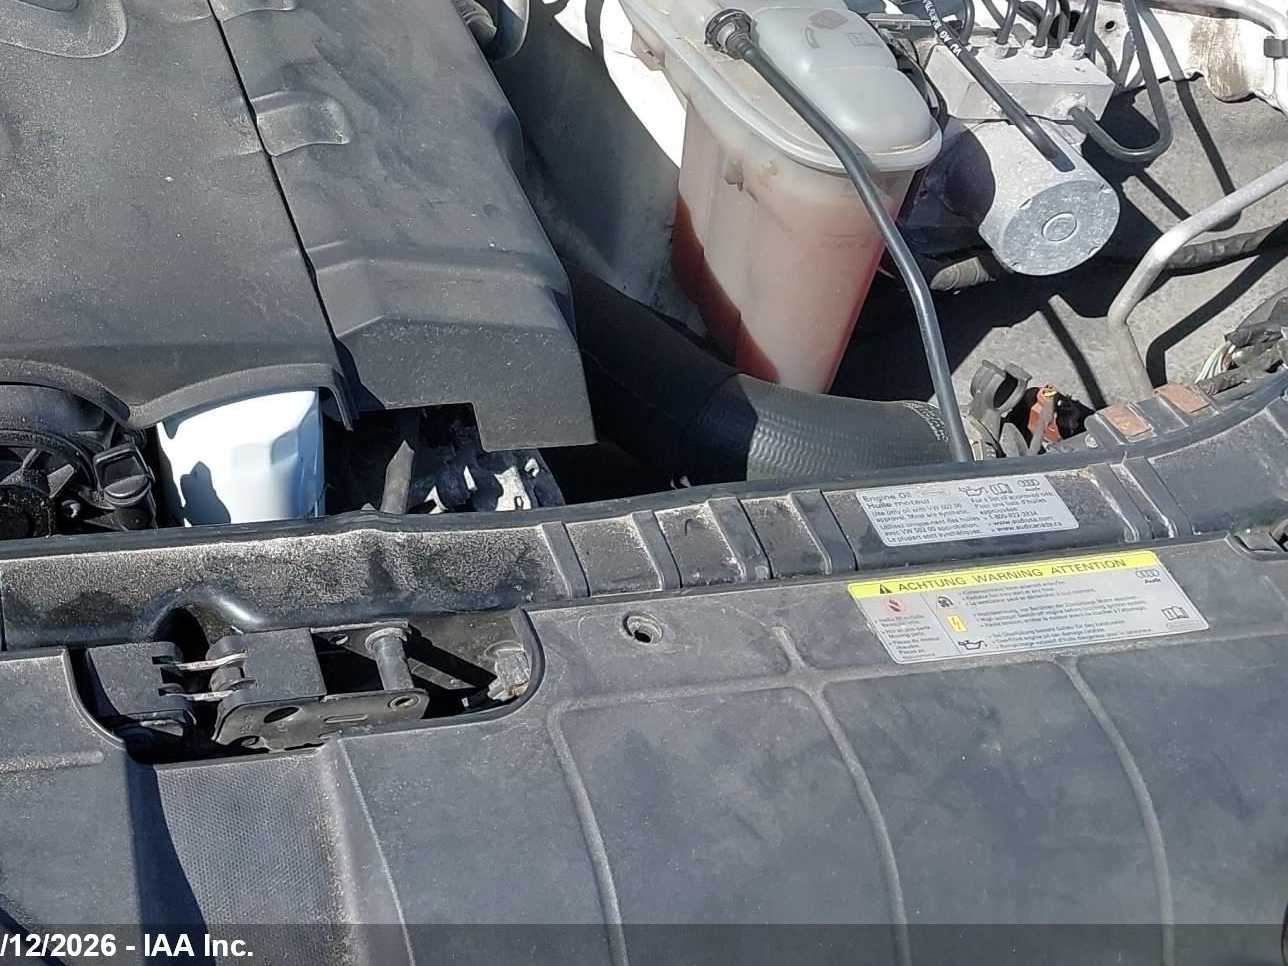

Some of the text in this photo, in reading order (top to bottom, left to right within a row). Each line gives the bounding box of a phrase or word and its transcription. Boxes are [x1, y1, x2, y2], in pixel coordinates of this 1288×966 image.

[863, 494, 897, 503] Engine
[897, 578, 967, 591] ACHTUNG
[972, 569, 1044, 583] WARNING
[1049, 560, 1128, 574] ATTENTION
